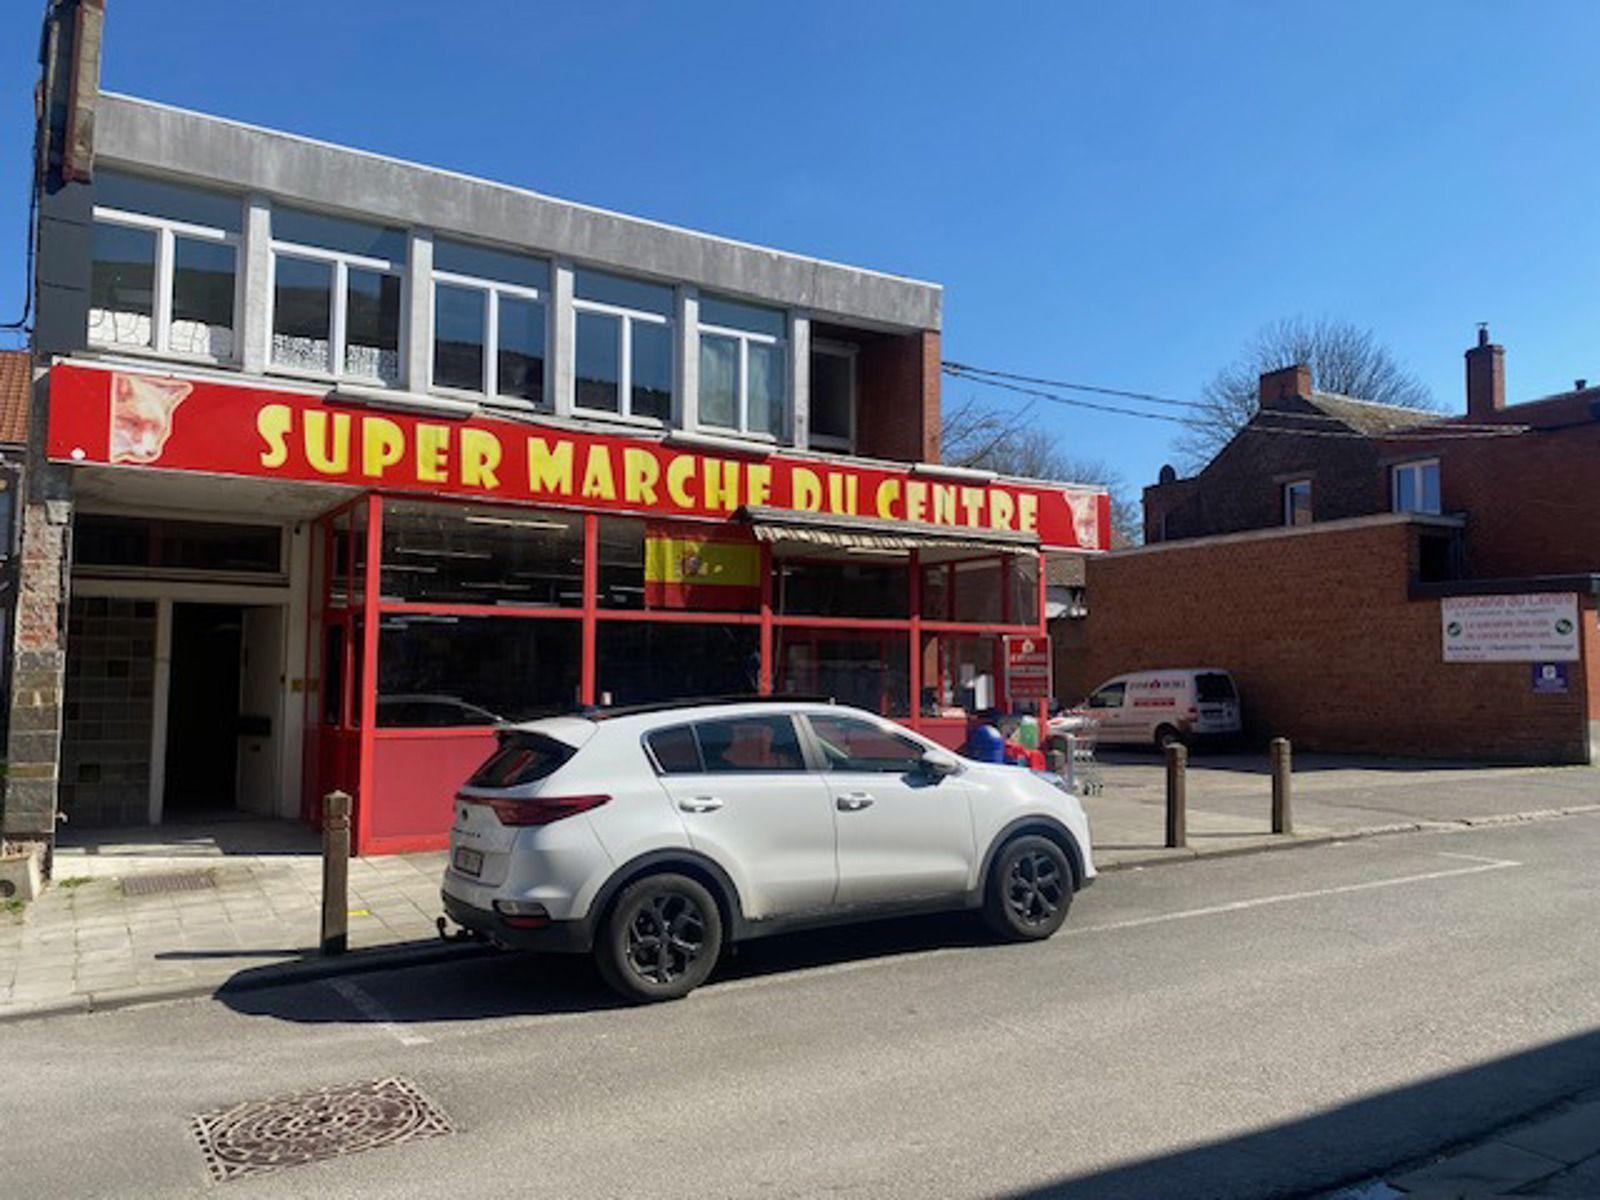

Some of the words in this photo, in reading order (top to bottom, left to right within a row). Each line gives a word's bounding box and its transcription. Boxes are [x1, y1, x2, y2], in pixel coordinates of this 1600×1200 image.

[257, 403, 502, 490] SUPER
[527, 436, 772, 511] MARCHE
[791, 466, 858, 516] DU
[875, 478, 1040, 534] CENTRE
